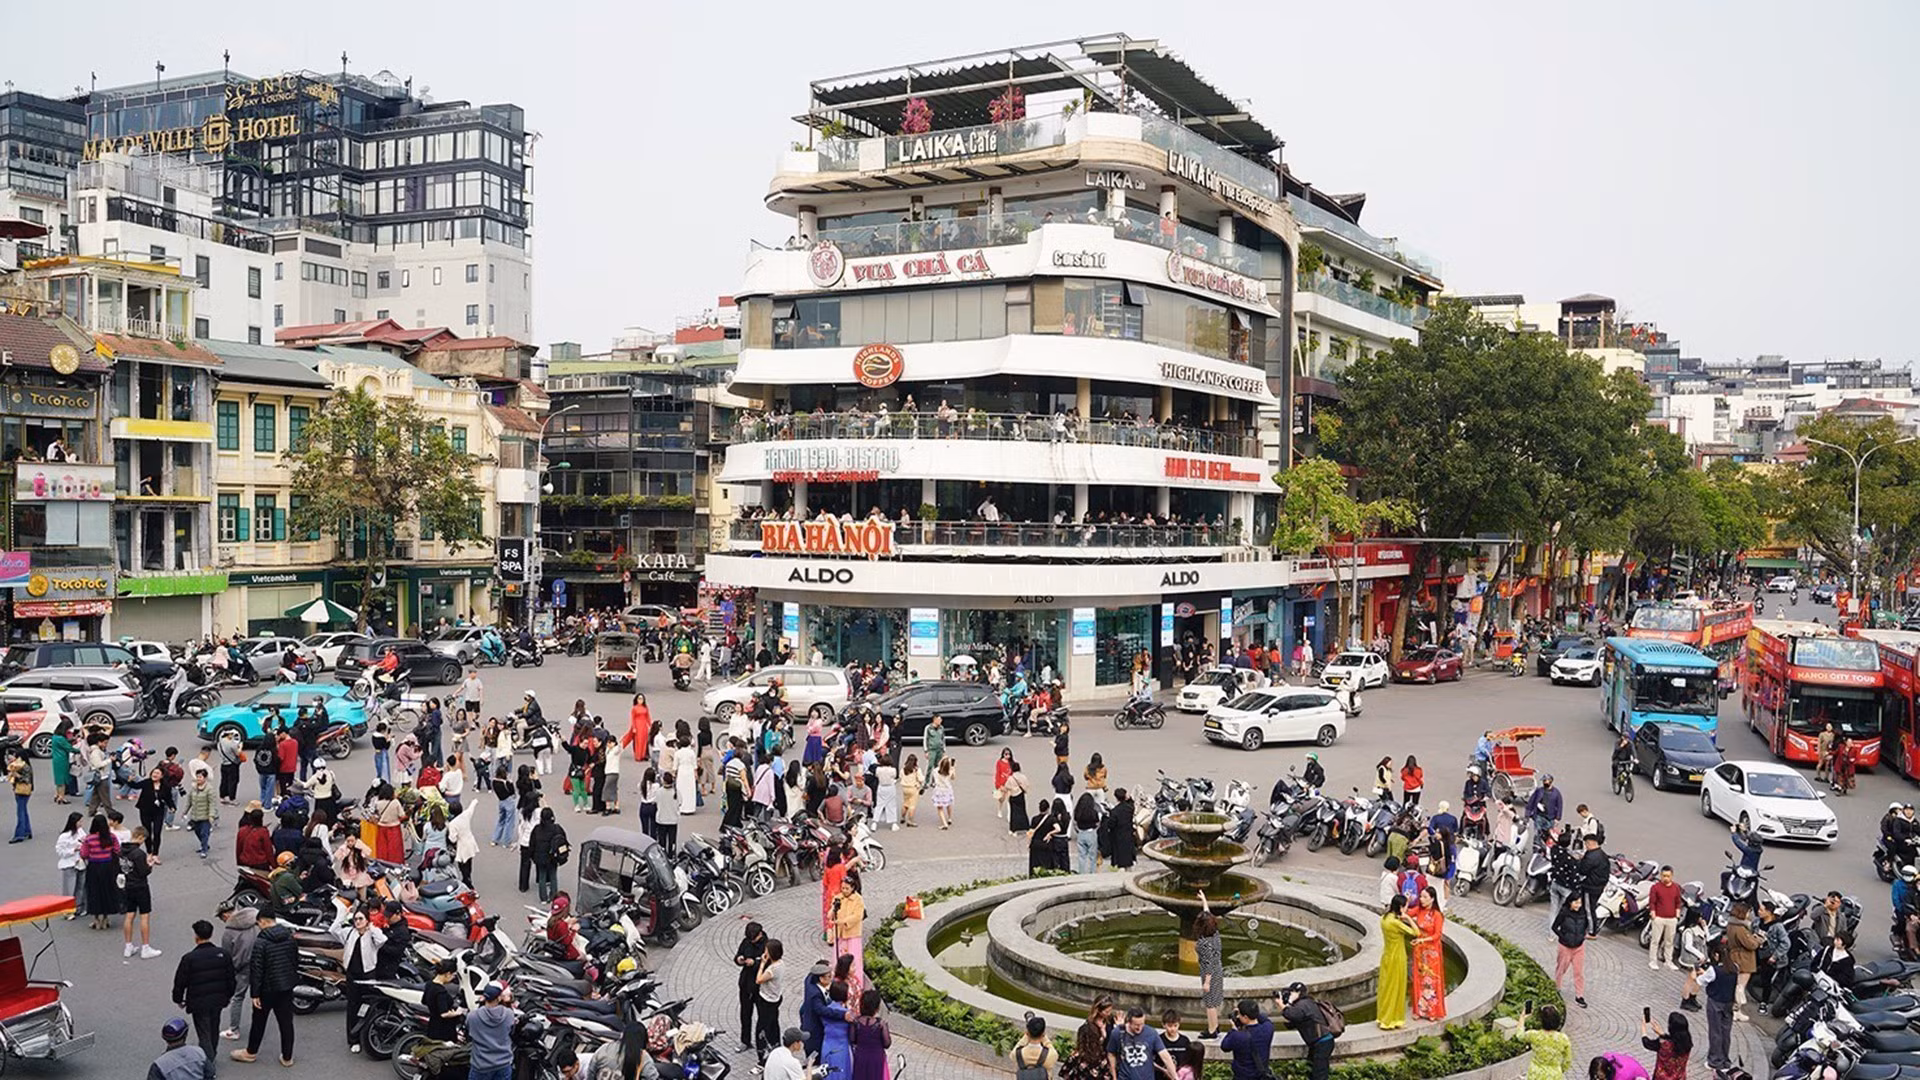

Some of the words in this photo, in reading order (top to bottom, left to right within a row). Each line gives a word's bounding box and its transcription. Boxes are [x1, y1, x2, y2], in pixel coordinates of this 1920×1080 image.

[83, 138, 117, 161] MAY
[149, 128, 195, 152] VILLE
[237, 115, 300, 142] HOTEL
[899, 133, 966, 164] LAIKA
[969, 130, 998, 154] Café
[1167, 149, 1206, 187] LAIKA
[1085, 171, 1134, 189] LAIKA
[852, 261, 897, 282] VUA
[956, 250, 990, 273] CÁ
[856, 346, 900, 366] HIGHLANDS
[861, 374, 896, 386] COFFEE
[844, 447, 900, 473] BISTRO
[762, 520, 803, 552] BIA
[804, 517, 842, 553] HÀ
[843, 516, 896, 559] NỘI
[504, 549, 519, 559] FS
[637, 553, 689, 569] KAFA
[501, 560, 522, 571] SPA
[251, 574, 298, 583] Vietcombank
[648, 570, 676, 581] Café
[788, 567, 854, 584] ALDO
[1160, 570, 1200, 587] ALDO
[1014, 595, 1054, 604] ALDO
[1797, 671, 1828, 680] HANOI
[1829, 672, 1850, 681] CITY
[1851, 674, 1877, 684] TOUR
